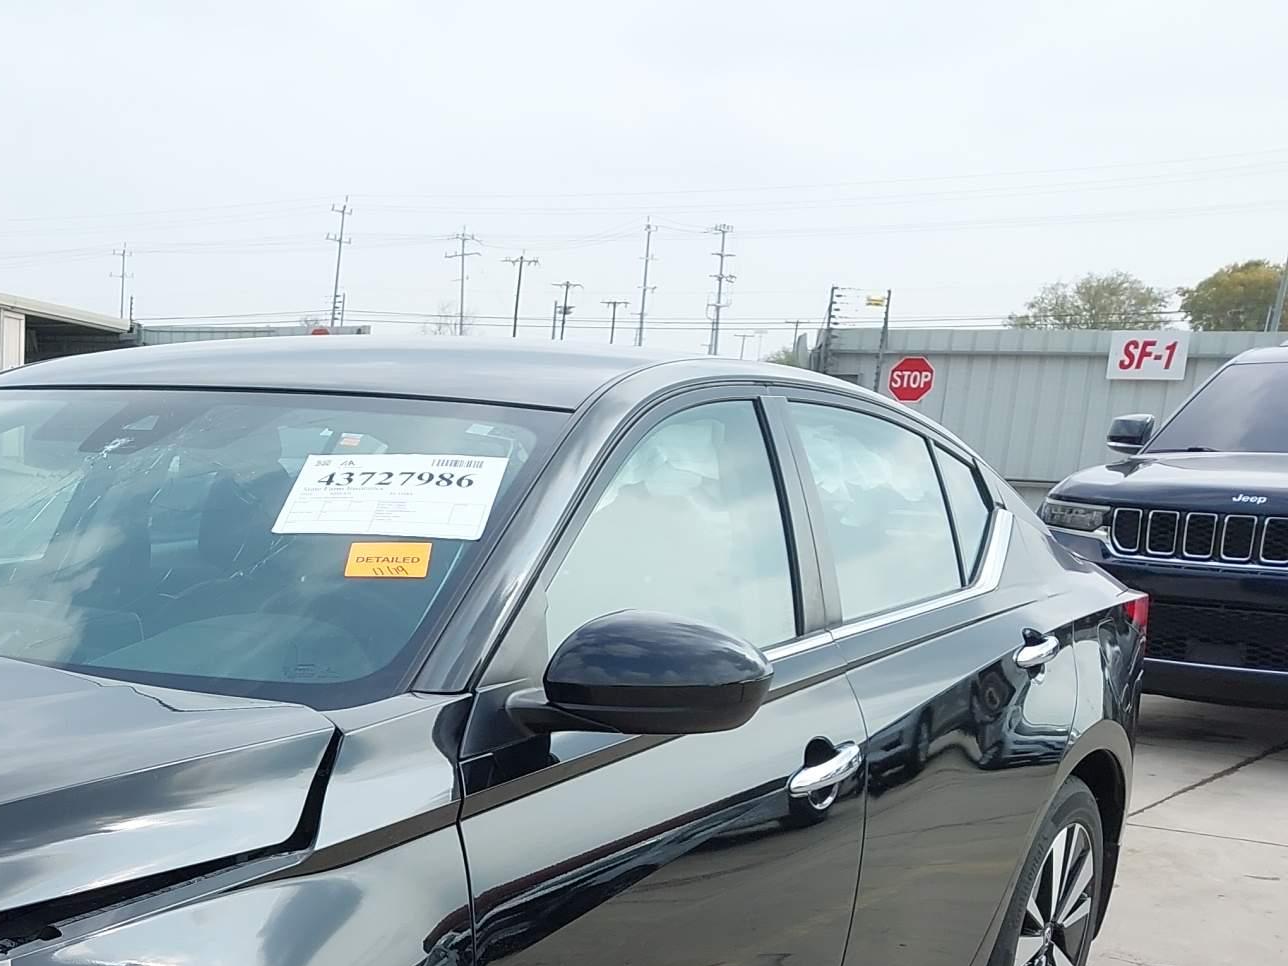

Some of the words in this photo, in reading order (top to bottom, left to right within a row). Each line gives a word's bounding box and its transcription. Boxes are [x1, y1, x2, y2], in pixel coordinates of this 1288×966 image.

[1119, 340, 1179, 370] SF-1
[891, 370, 932, 389] STOP
[317, 471, 478, 488] 43727986
[1232, 494, 1267, 504] Jeep
[355, 556, 421, 564] DETAILED
